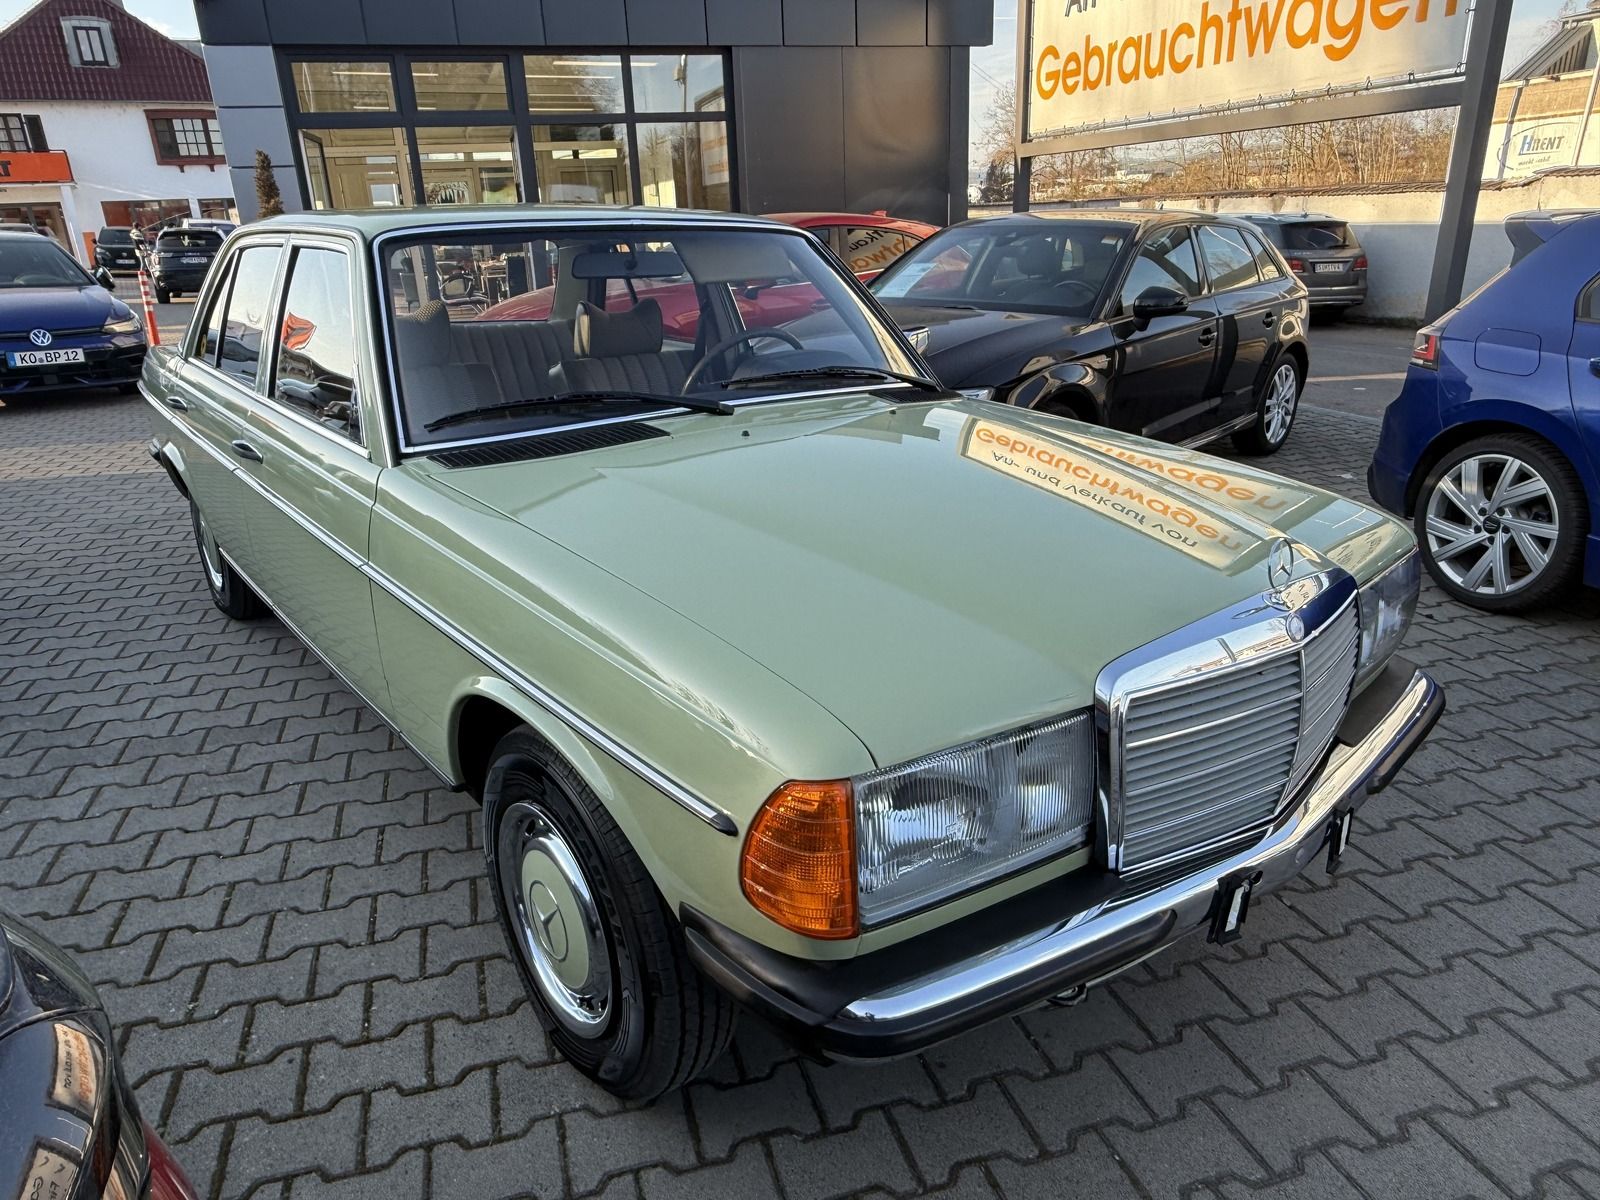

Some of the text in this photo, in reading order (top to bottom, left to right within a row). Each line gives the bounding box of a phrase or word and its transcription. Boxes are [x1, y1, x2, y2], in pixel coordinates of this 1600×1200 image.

[19, 350, 80, 365] KO BP 12
